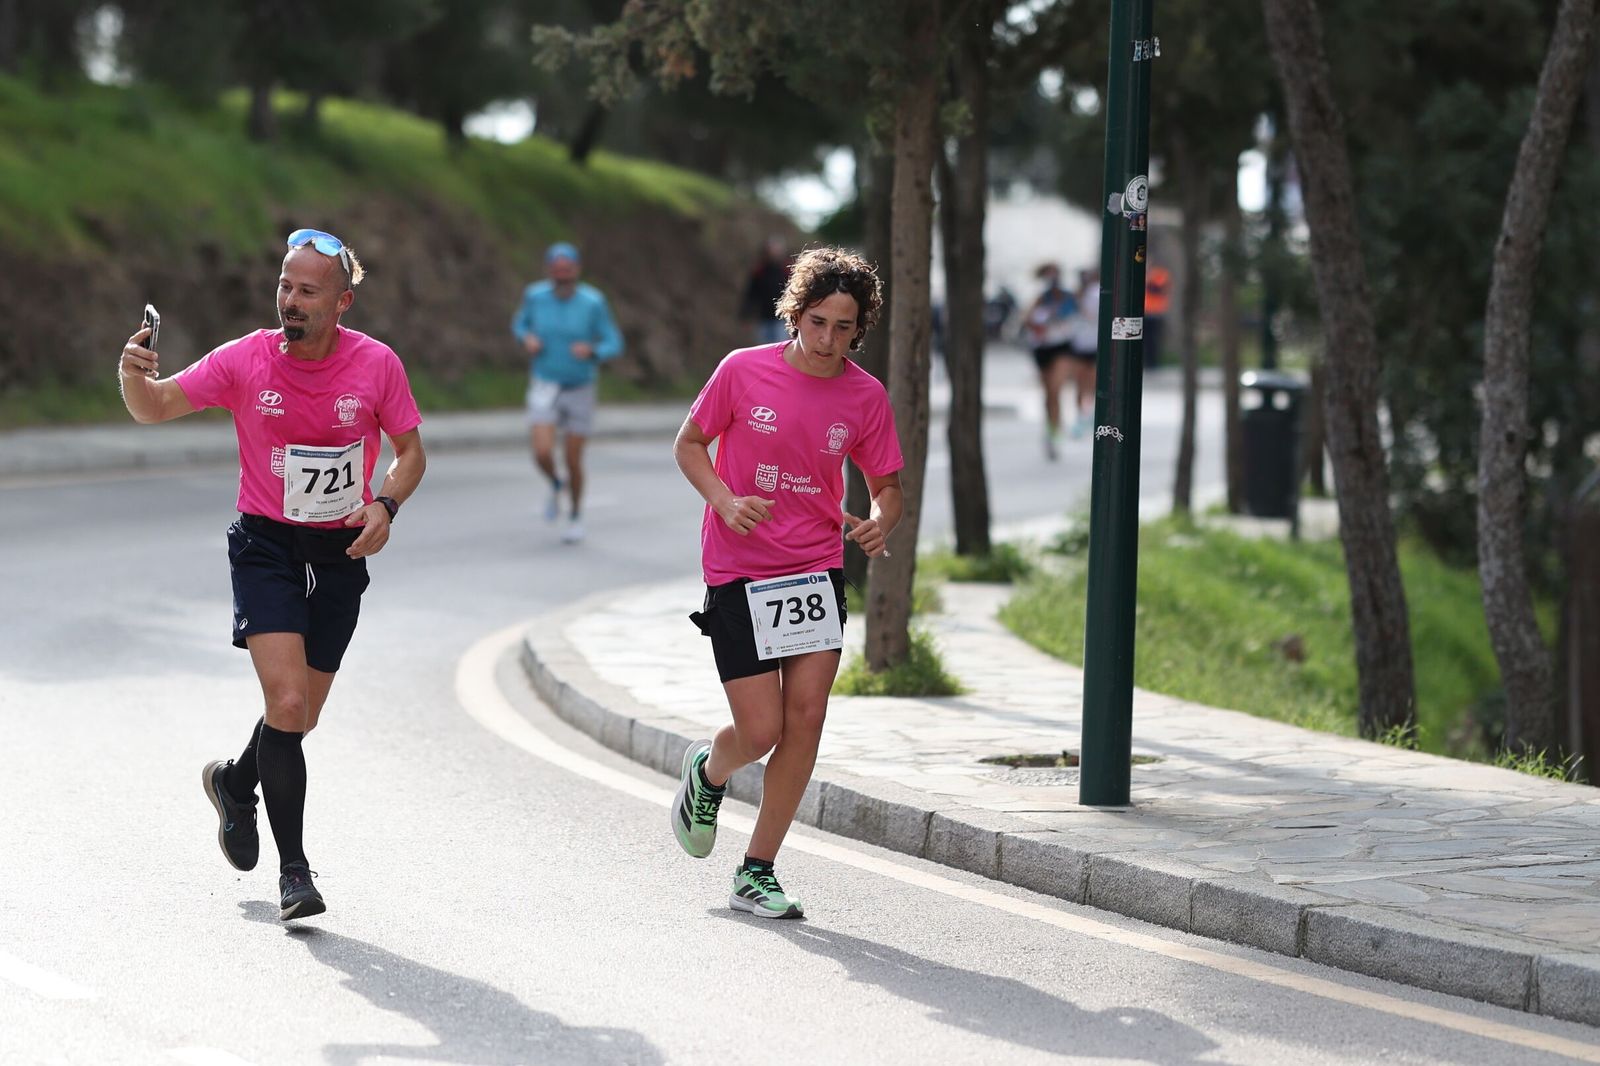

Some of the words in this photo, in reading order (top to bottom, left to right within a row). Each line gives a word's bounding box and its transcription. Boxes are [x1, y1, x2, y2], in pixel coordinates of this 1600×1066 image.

[255, 405, 285, 415] HYUNDAI
[747, 419, 778, 433] HYUNDAI
[301, 460, 355, 495] 721
[781, 472, 812, 484] Ciudad
[780, 481, 791, 490] de
[791, 484, 822, 495] Málaga
[765, 593, 827, 629] 738
